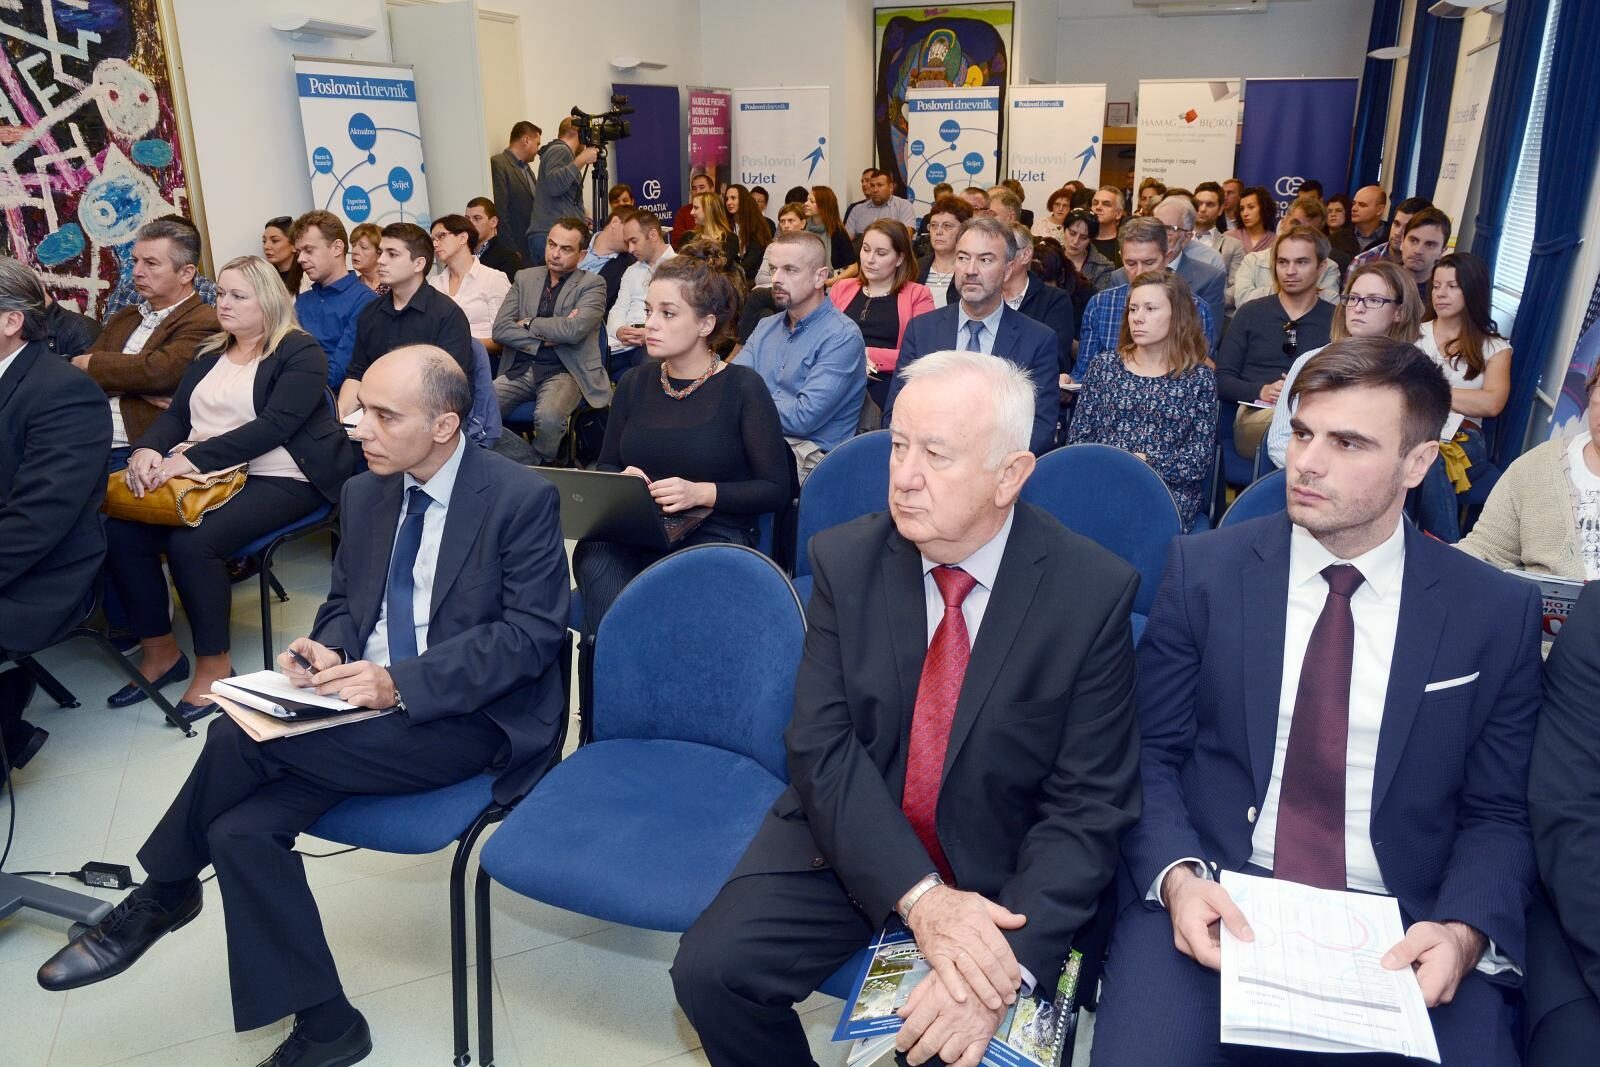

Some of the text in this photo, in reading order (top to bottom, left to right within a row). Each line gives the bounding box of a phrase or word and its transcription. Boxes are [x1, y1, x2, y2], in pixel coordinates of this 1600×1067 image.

[308, 77, 408, 98] Poslovni dnevnik
[917, 99, 992, 111] Poslovni dnevnik
[1140, 119, 1177, 127] HAMAG
[350, 127, 375, 135] Aktualno
[742, 155, 796, 168] Poslovni
[966, 160, 982, 169] Svijet
[1011, 152, 1067, 165] Poslovni
[742, 171, 776, 184] Uzlet
[1011, 169, 1047, 182] Uzlet
[391, 179, 410, 190] Svijet
